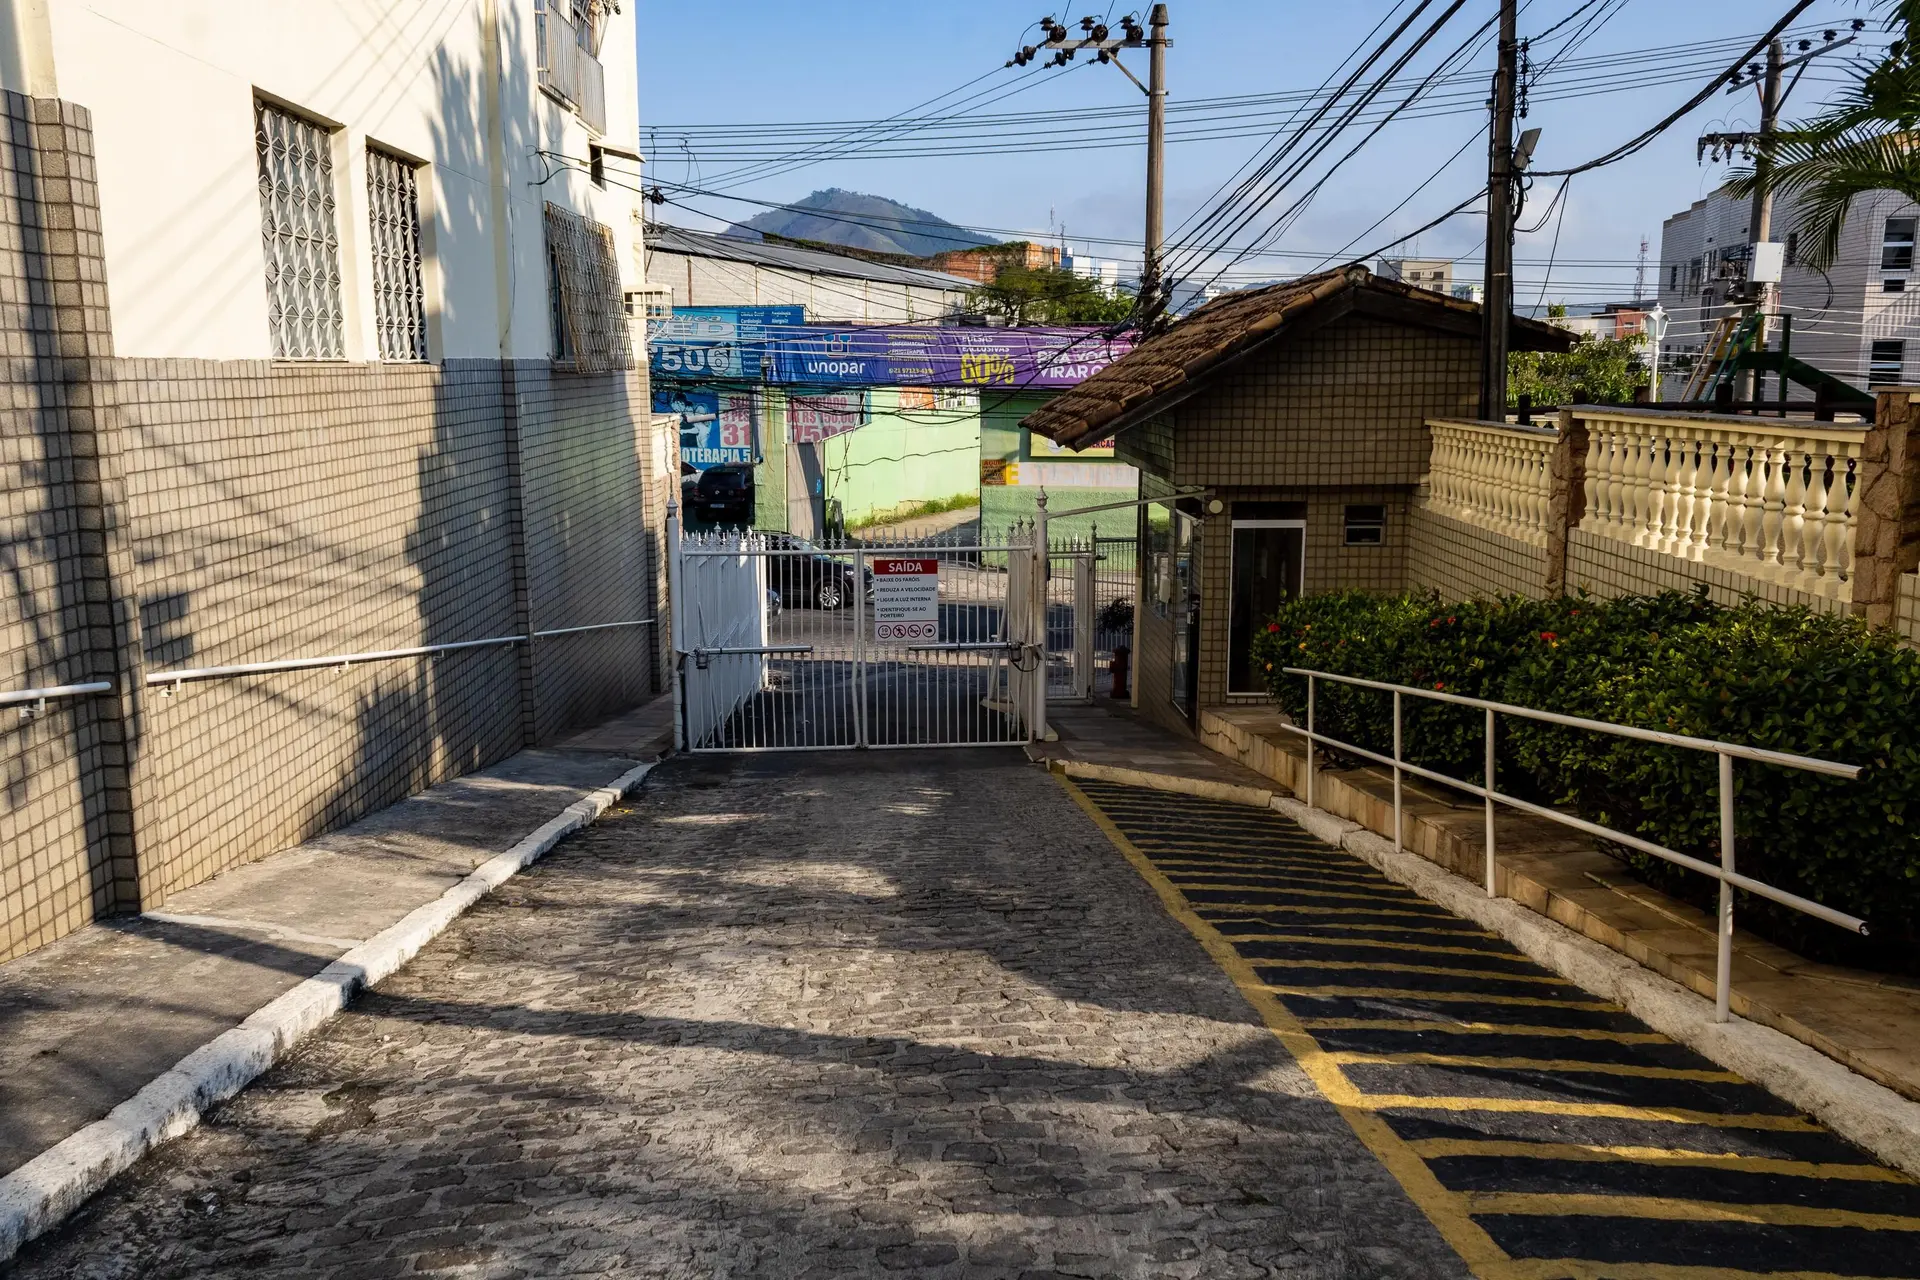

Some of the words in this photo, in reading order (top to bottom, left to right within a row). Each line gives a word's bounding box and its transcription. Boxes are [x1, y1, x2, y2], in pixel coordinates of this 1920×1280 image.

[808, 361, 866, 378] unopar
[960, 353, 1015, 384] 60%
[1037, 365, 1088, 378] VIRAR
[888, 561, 923, 572] SAÍDA
